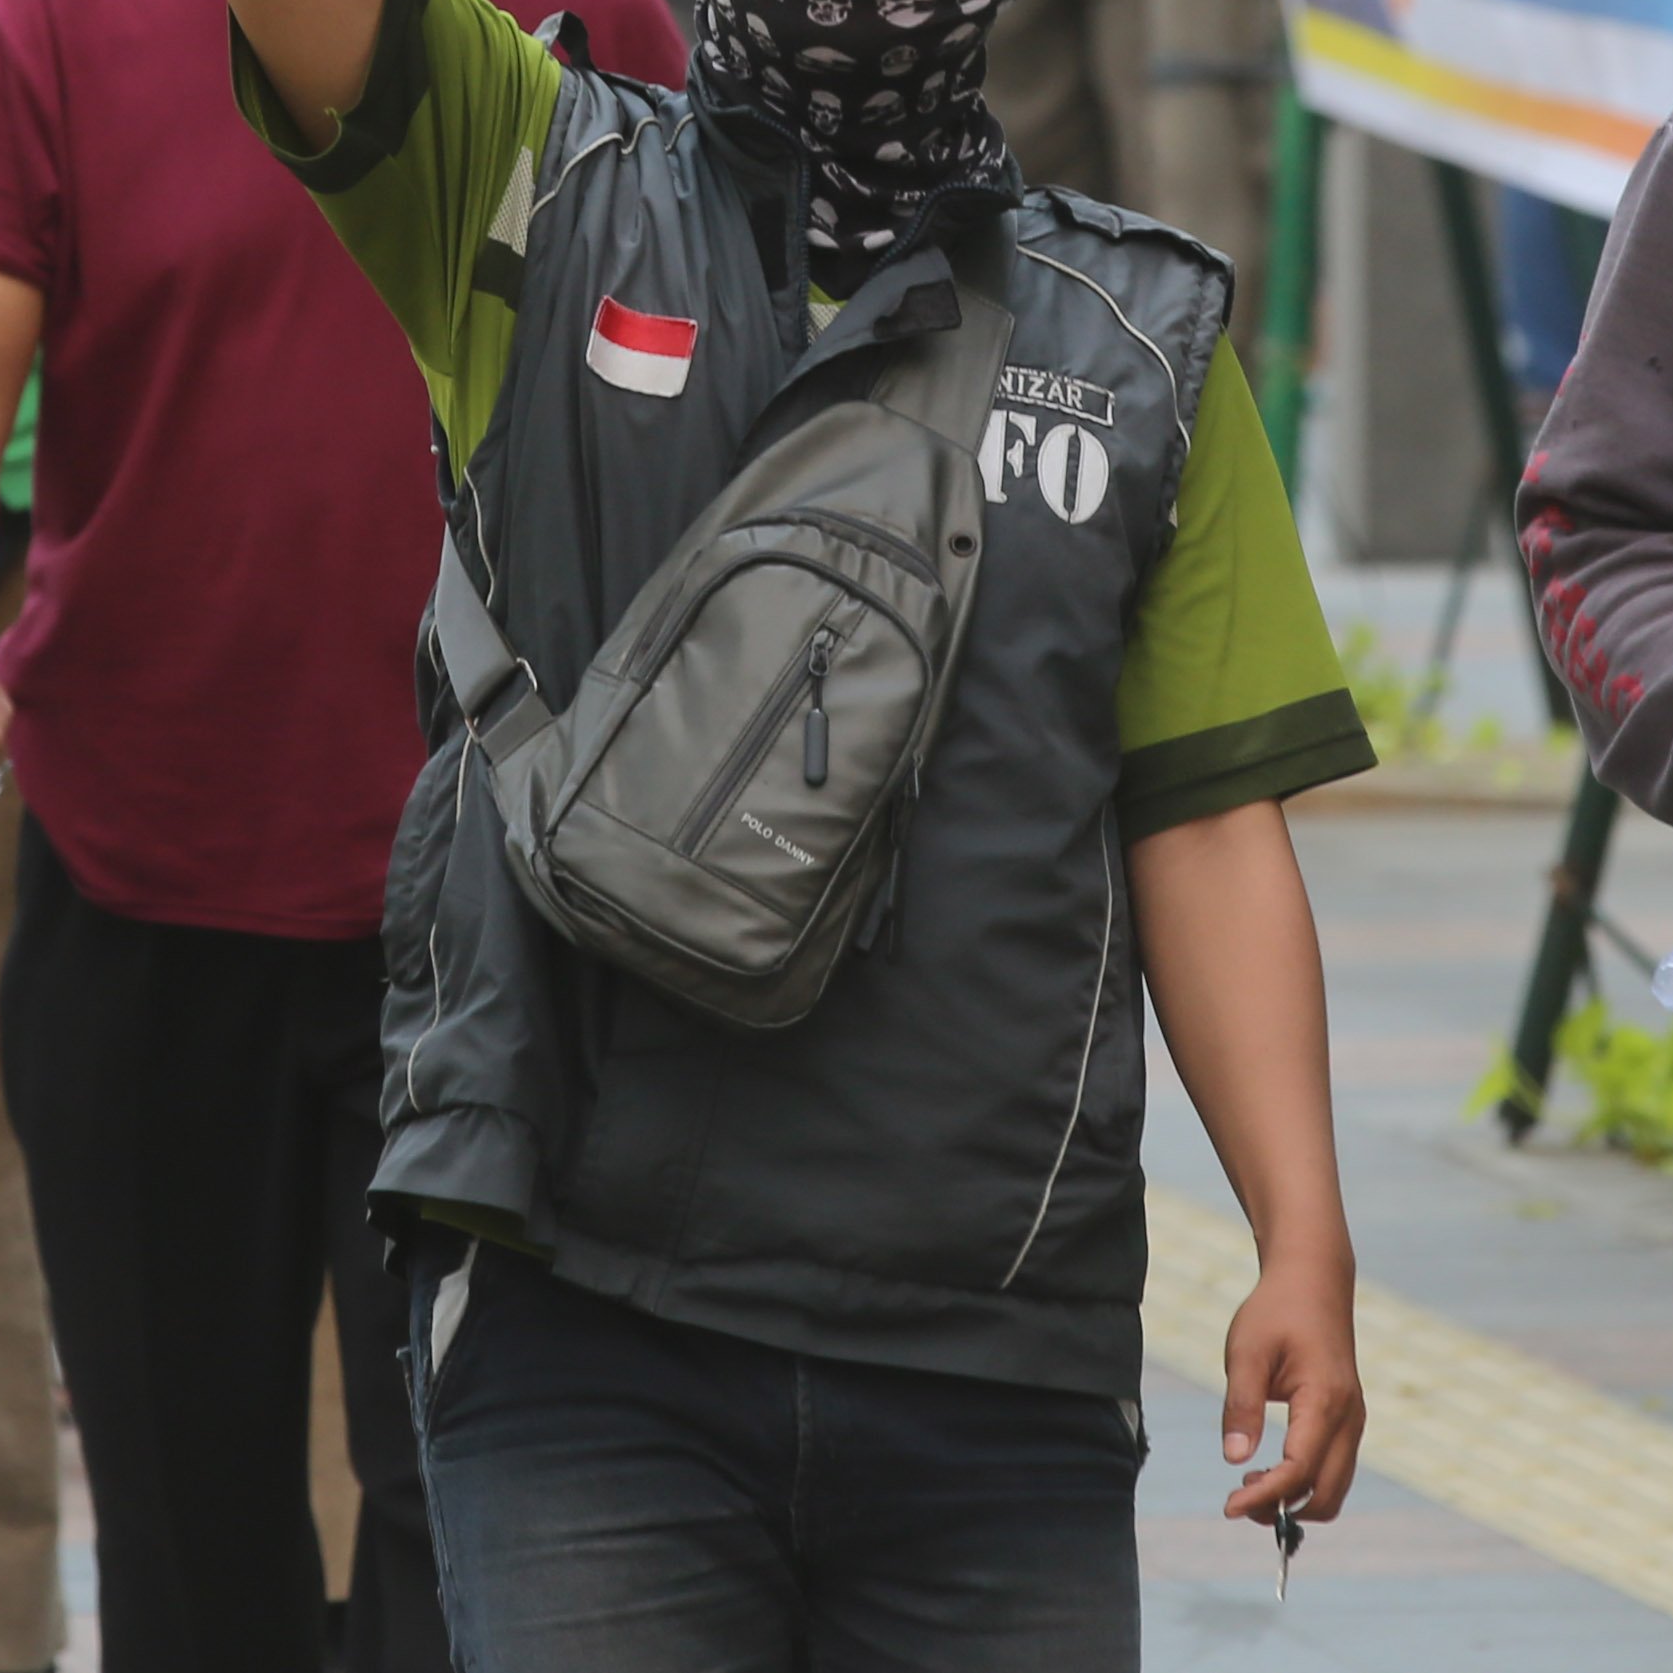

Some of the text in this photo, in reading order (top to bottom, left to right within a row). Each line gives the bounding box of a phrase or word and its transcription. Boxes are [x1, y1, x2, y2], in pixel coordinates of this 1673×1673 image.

[997, 371, 1083, 409] NIZAR
[978, 409, 1109, 524] FO
[741, 812, 815, 866] POLO DANNY
